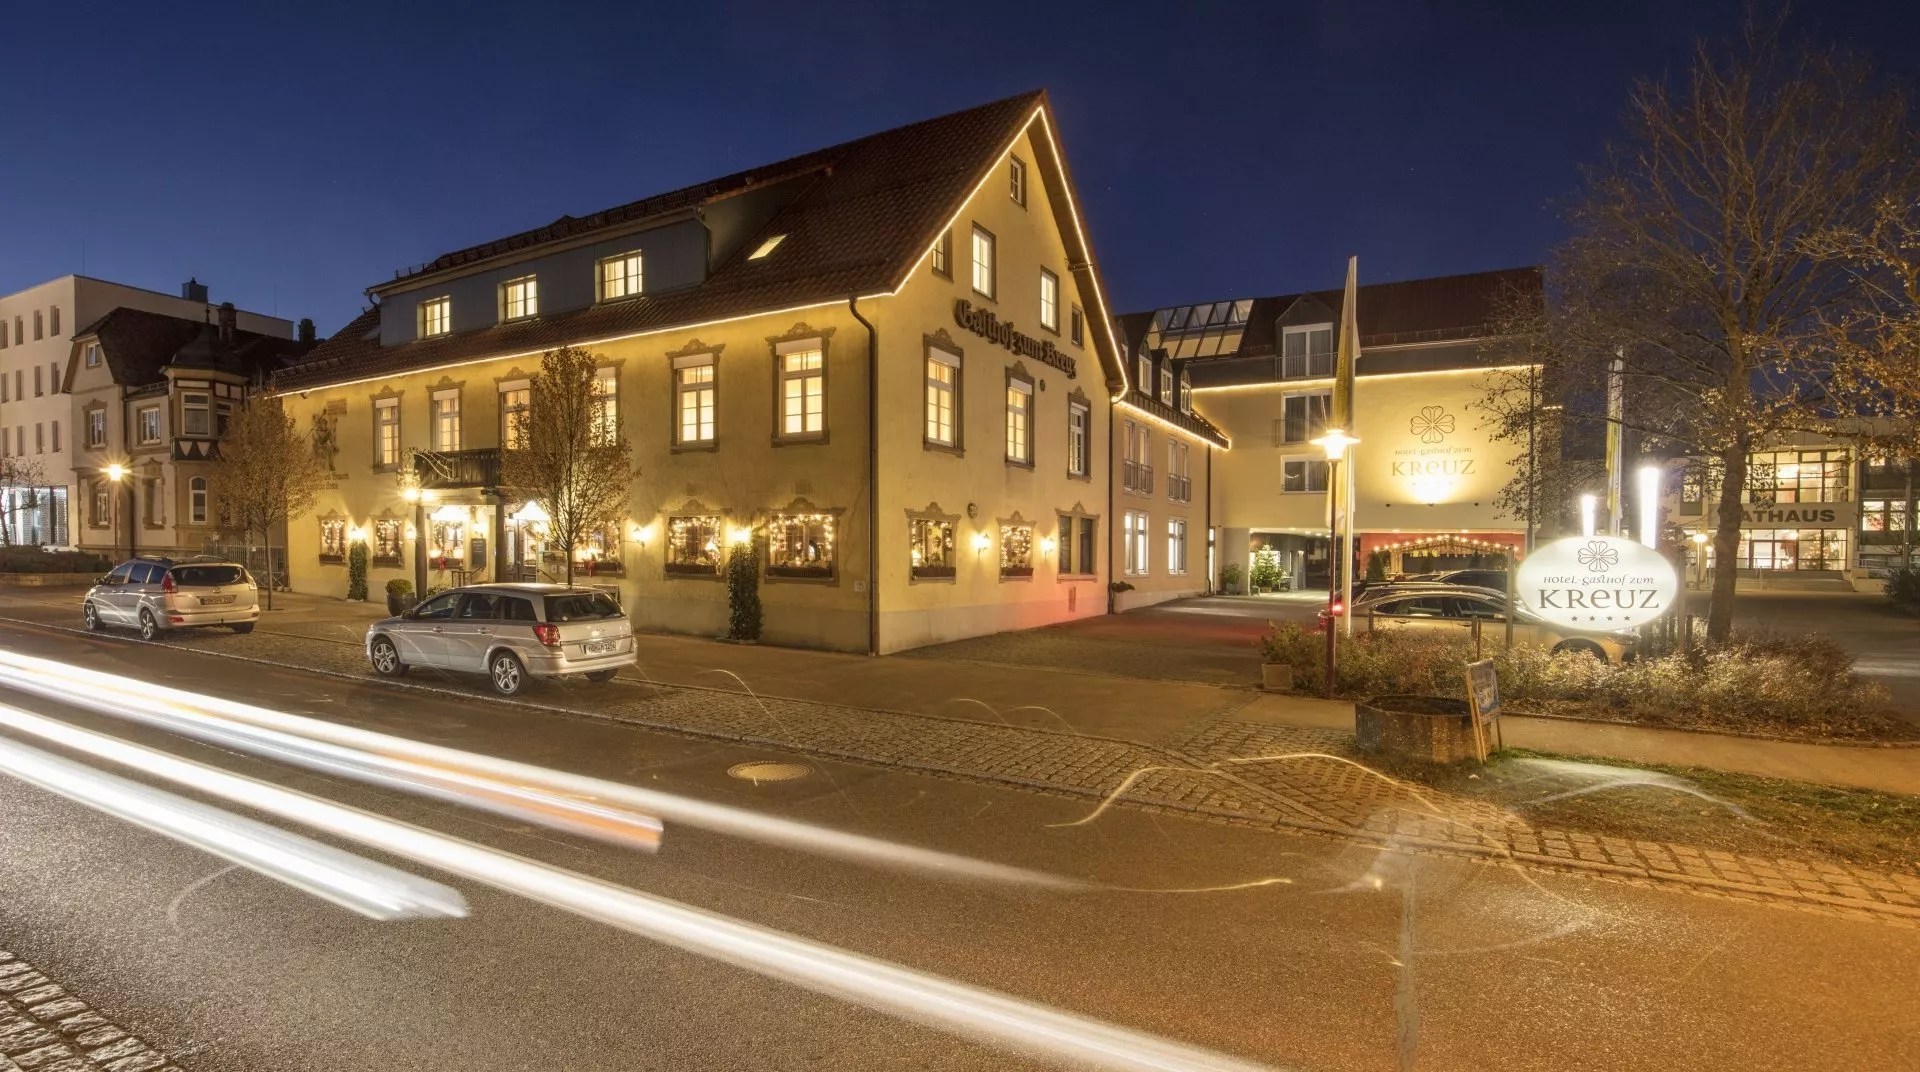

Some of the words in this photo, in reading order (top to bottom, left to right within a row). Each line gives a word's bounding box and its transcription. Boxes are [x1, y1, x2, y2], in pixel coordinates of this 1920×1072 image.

[1011, 331, 1042, 360] zum
[1041, 340, 1076, 379] Kreuz
[1741, 509, 1835, 522] ATHAUS
[1630, 576, 1654, 584] zum
